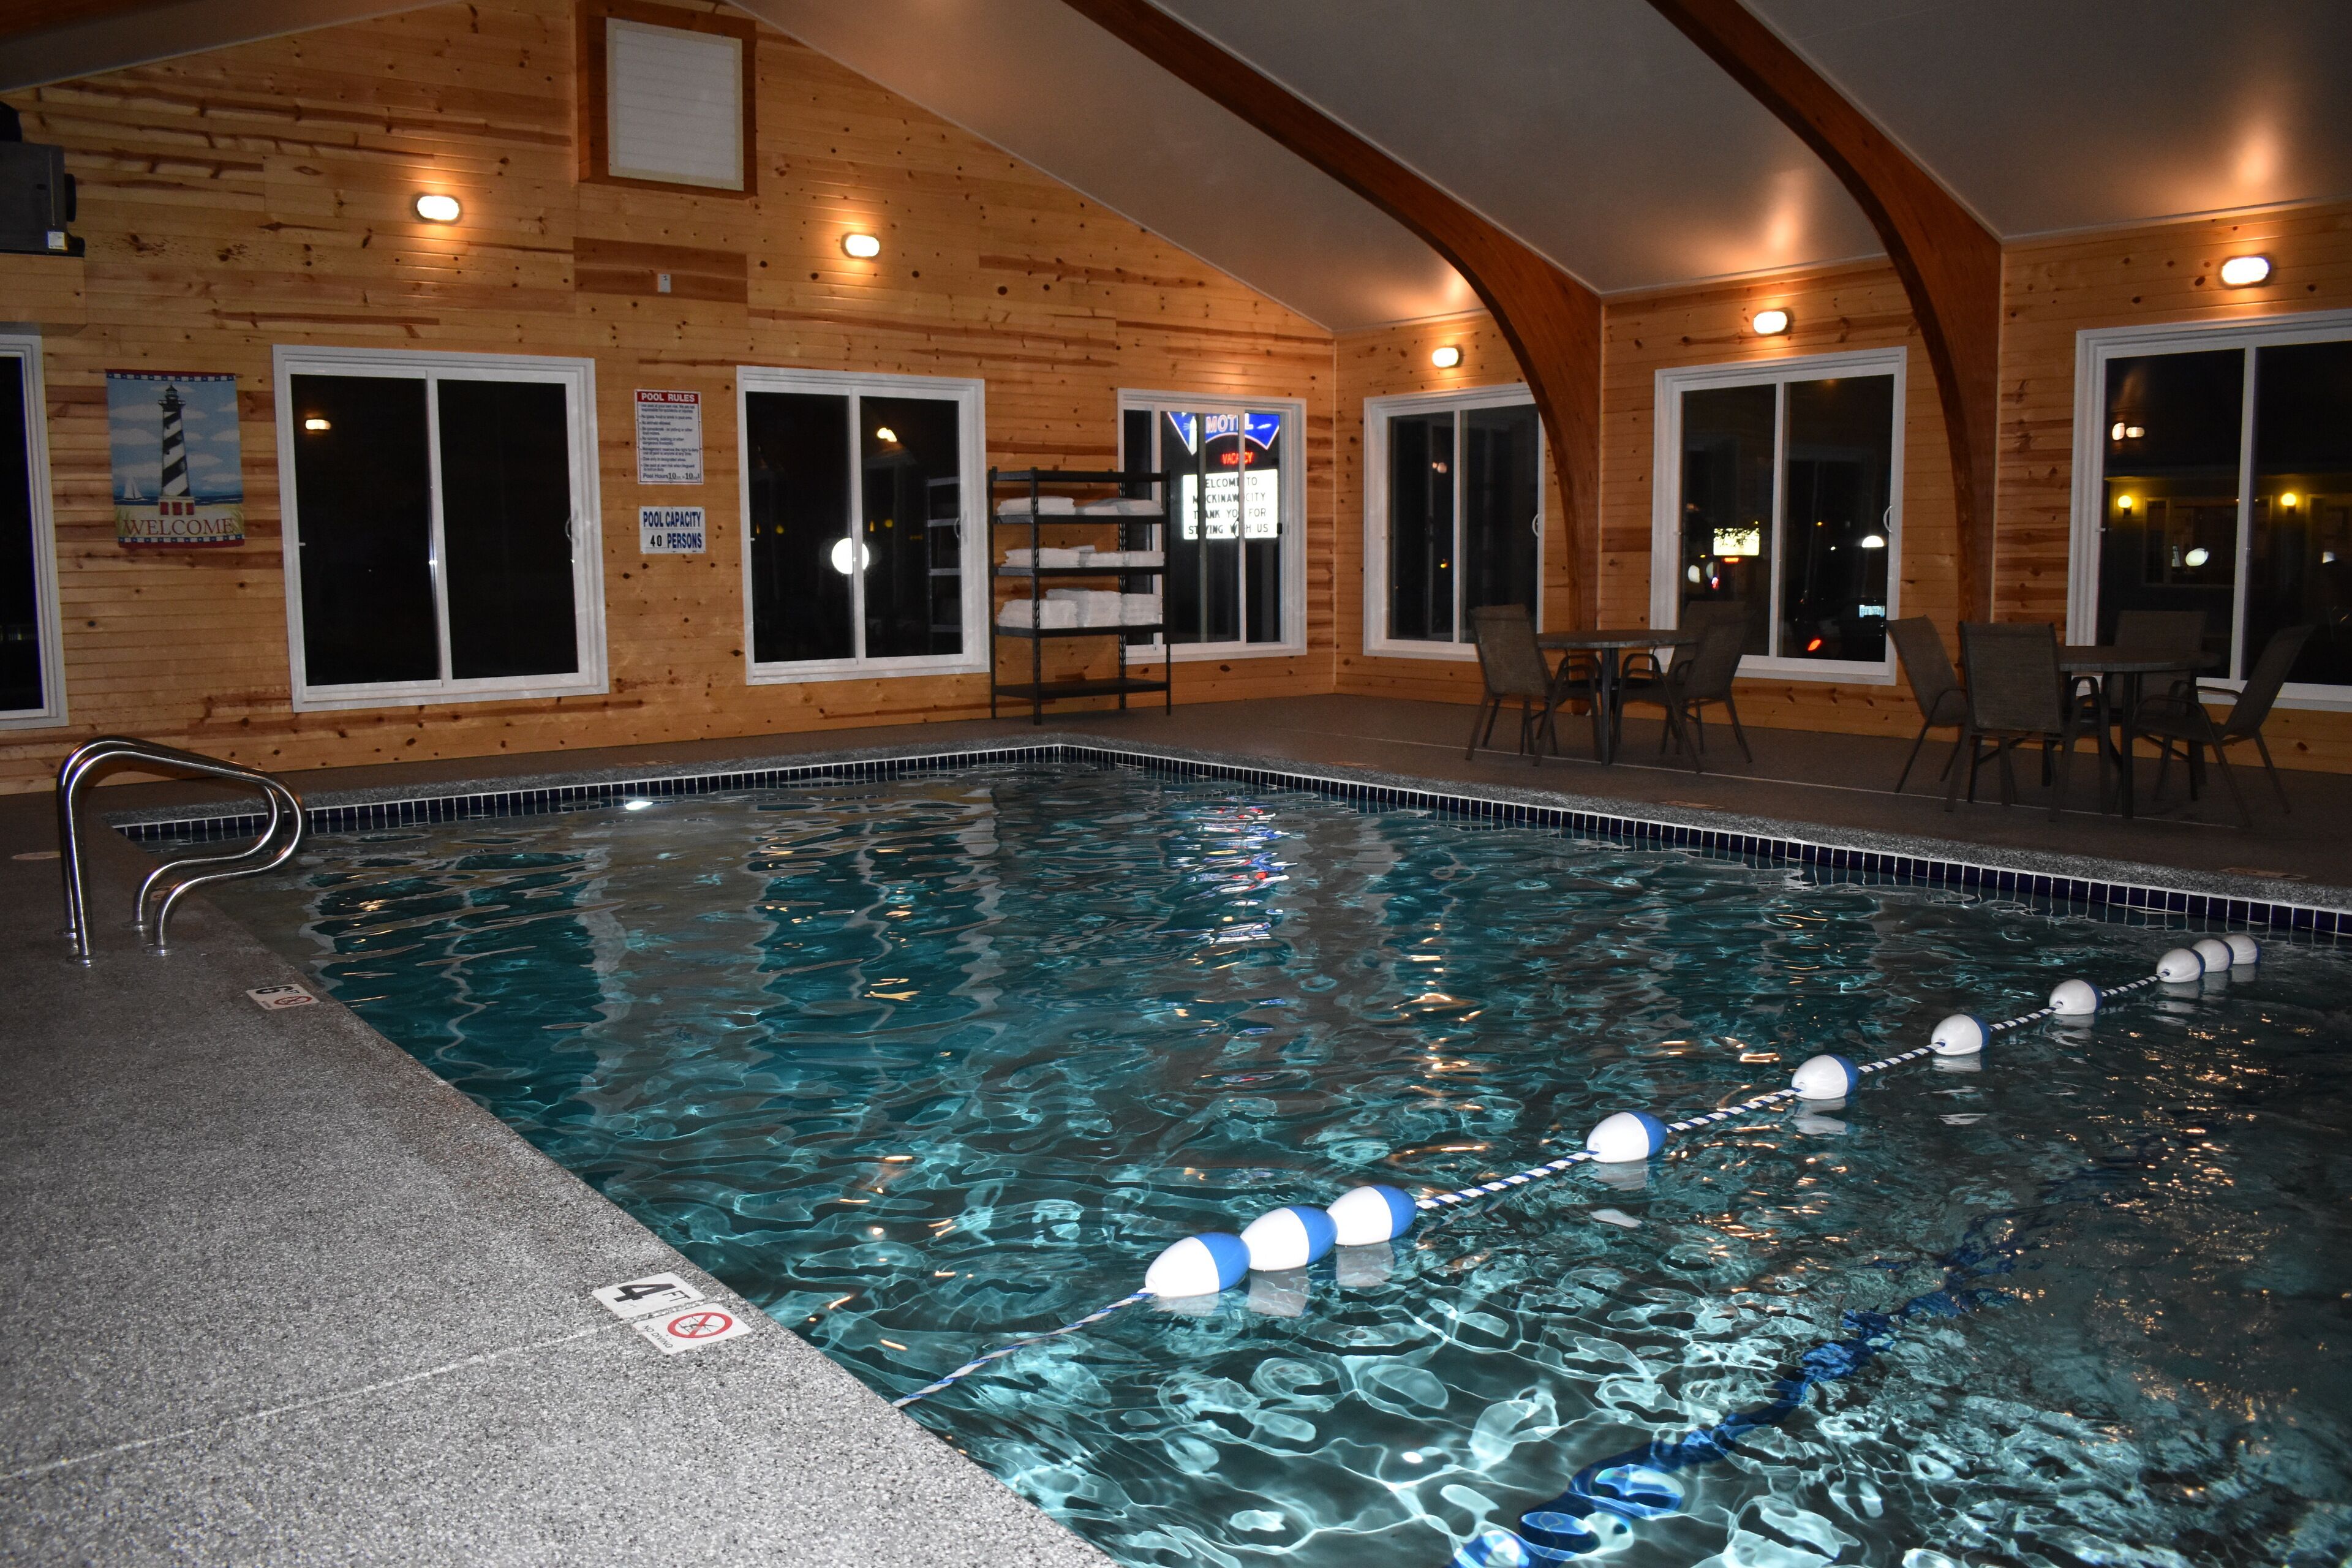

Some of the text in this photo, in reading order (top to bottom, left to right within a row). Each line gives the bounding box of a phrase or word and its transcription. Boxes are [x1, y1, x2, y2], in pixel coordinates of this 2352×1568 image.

[641, 393, 695, 402] POOL RULES
[1205, 413, 1254, 434] MOTL
[1222, 451, 1254, 464] VACACY
[1202, 477, 1257, 488] ELCOM TO
[1193, 492, 1265, 504] MCKINAW CITY
[643, 511, 701, 527] POOL CAPACITY
[1193, 508, 1266, 519] TANK YO FOR
[124, 518, 235, 535] WELCOME
[1188, 524, 1268, 535] STYING WH US
[650, 533, 702, 549] 40 PERSONS
[614, 1283, 691, 1303] 4 FT
[651, 1332, 673, 1348] DIVING
